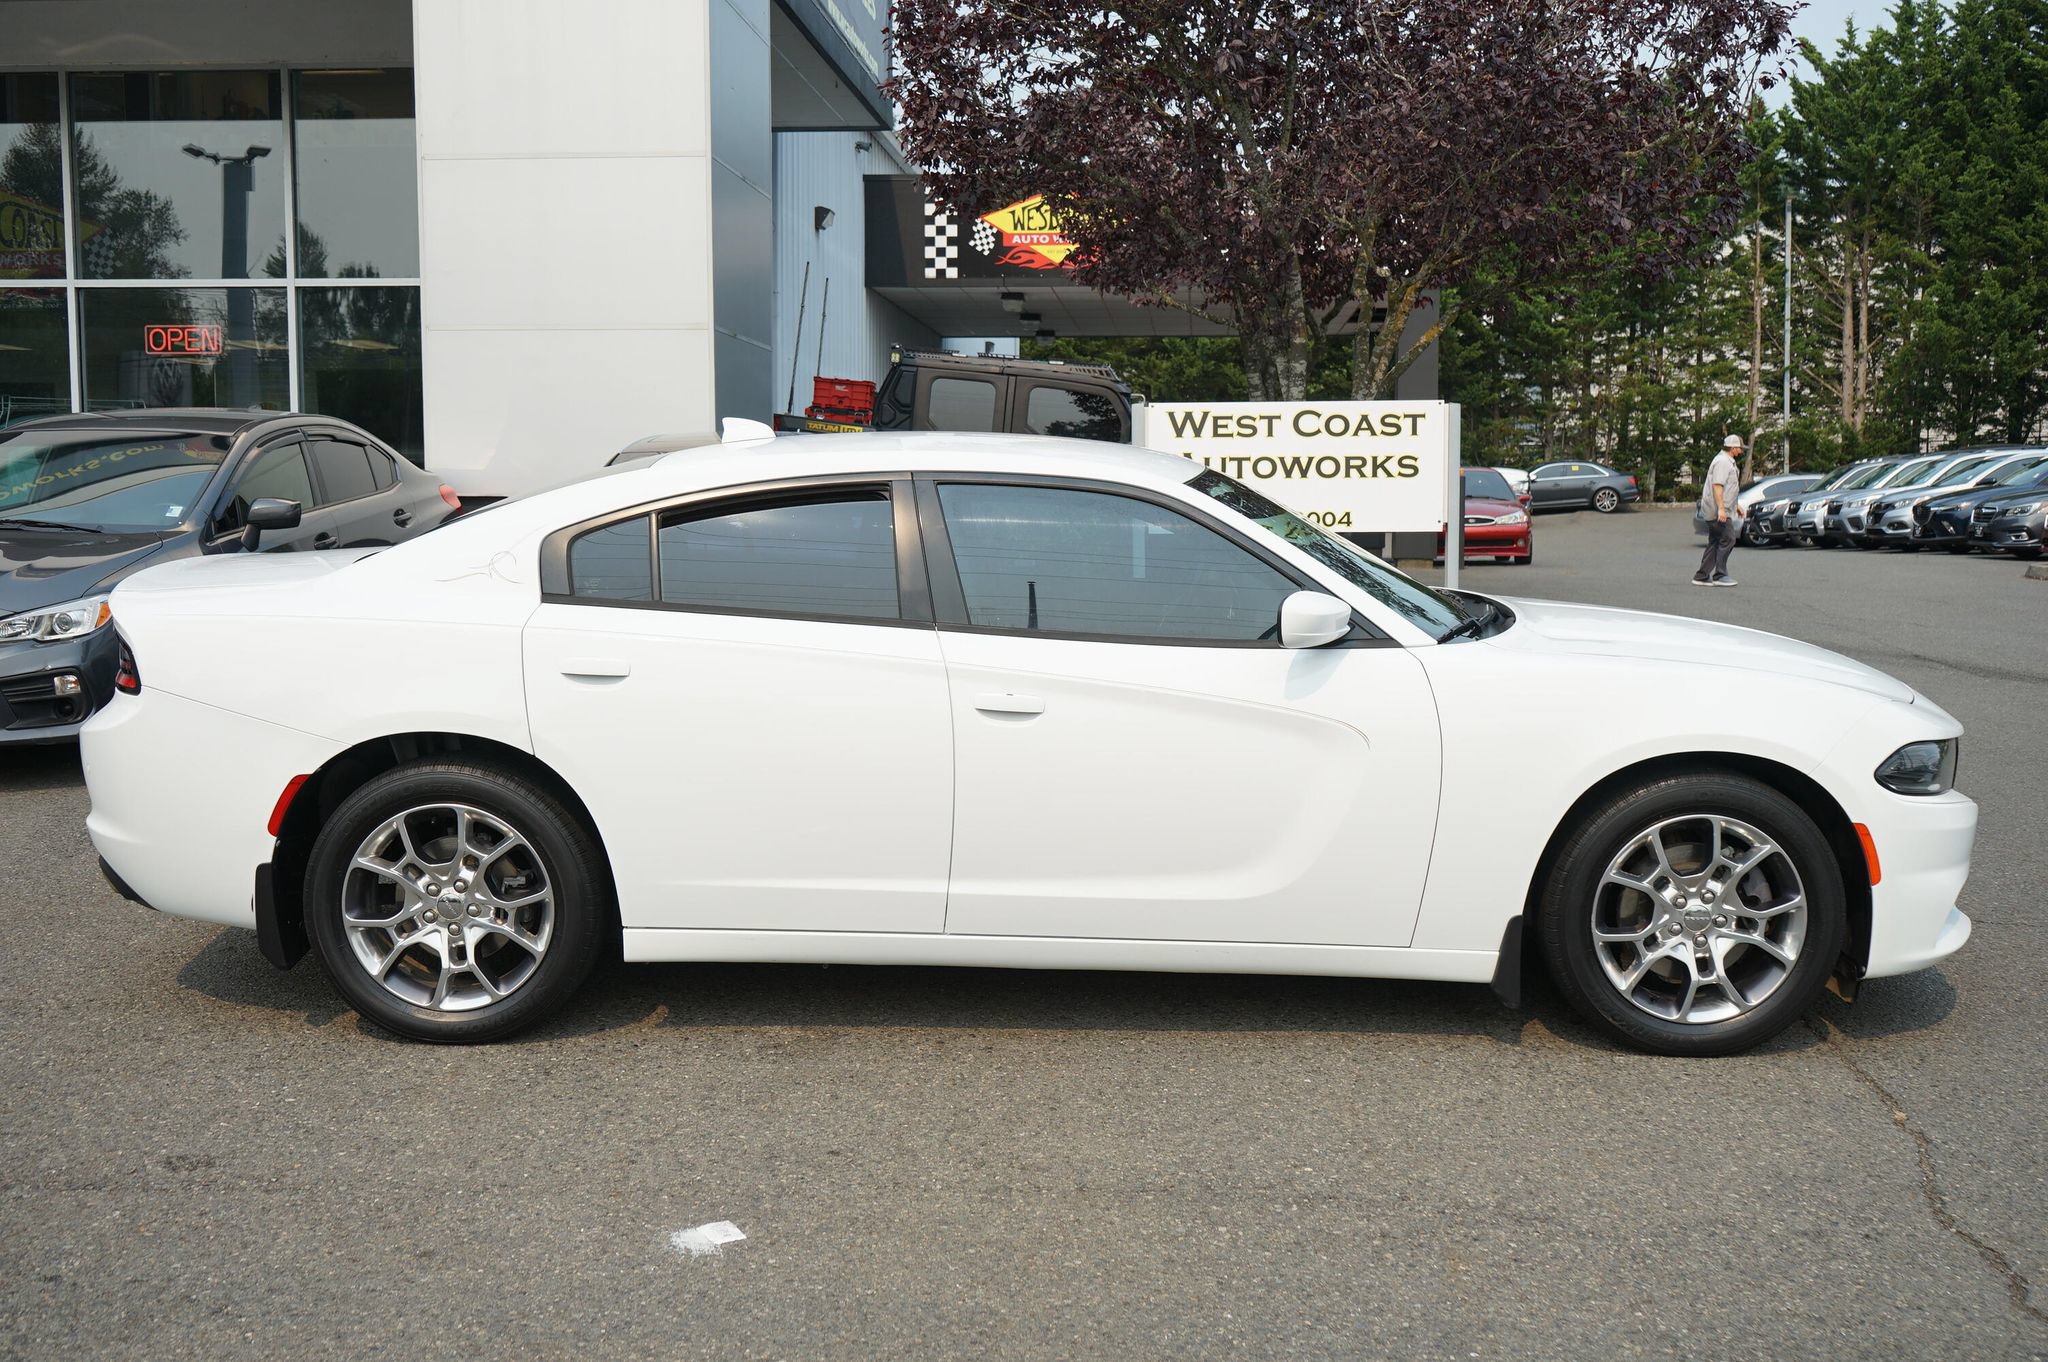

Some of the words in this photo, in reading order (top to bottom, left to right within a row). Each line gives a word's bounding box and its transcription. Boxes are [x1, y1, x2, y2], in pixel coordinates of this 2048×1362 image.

[1012, 235, 1049, 244] AUTO
[149, 328, 219, 352] OPEN
[808, 422, 839, 433] TATUM
[1167, 410, 1282, 438] WEST
[1292, 409, 1426, 438] COAST
[1183, 452, 1420, 479] TOWORKS
